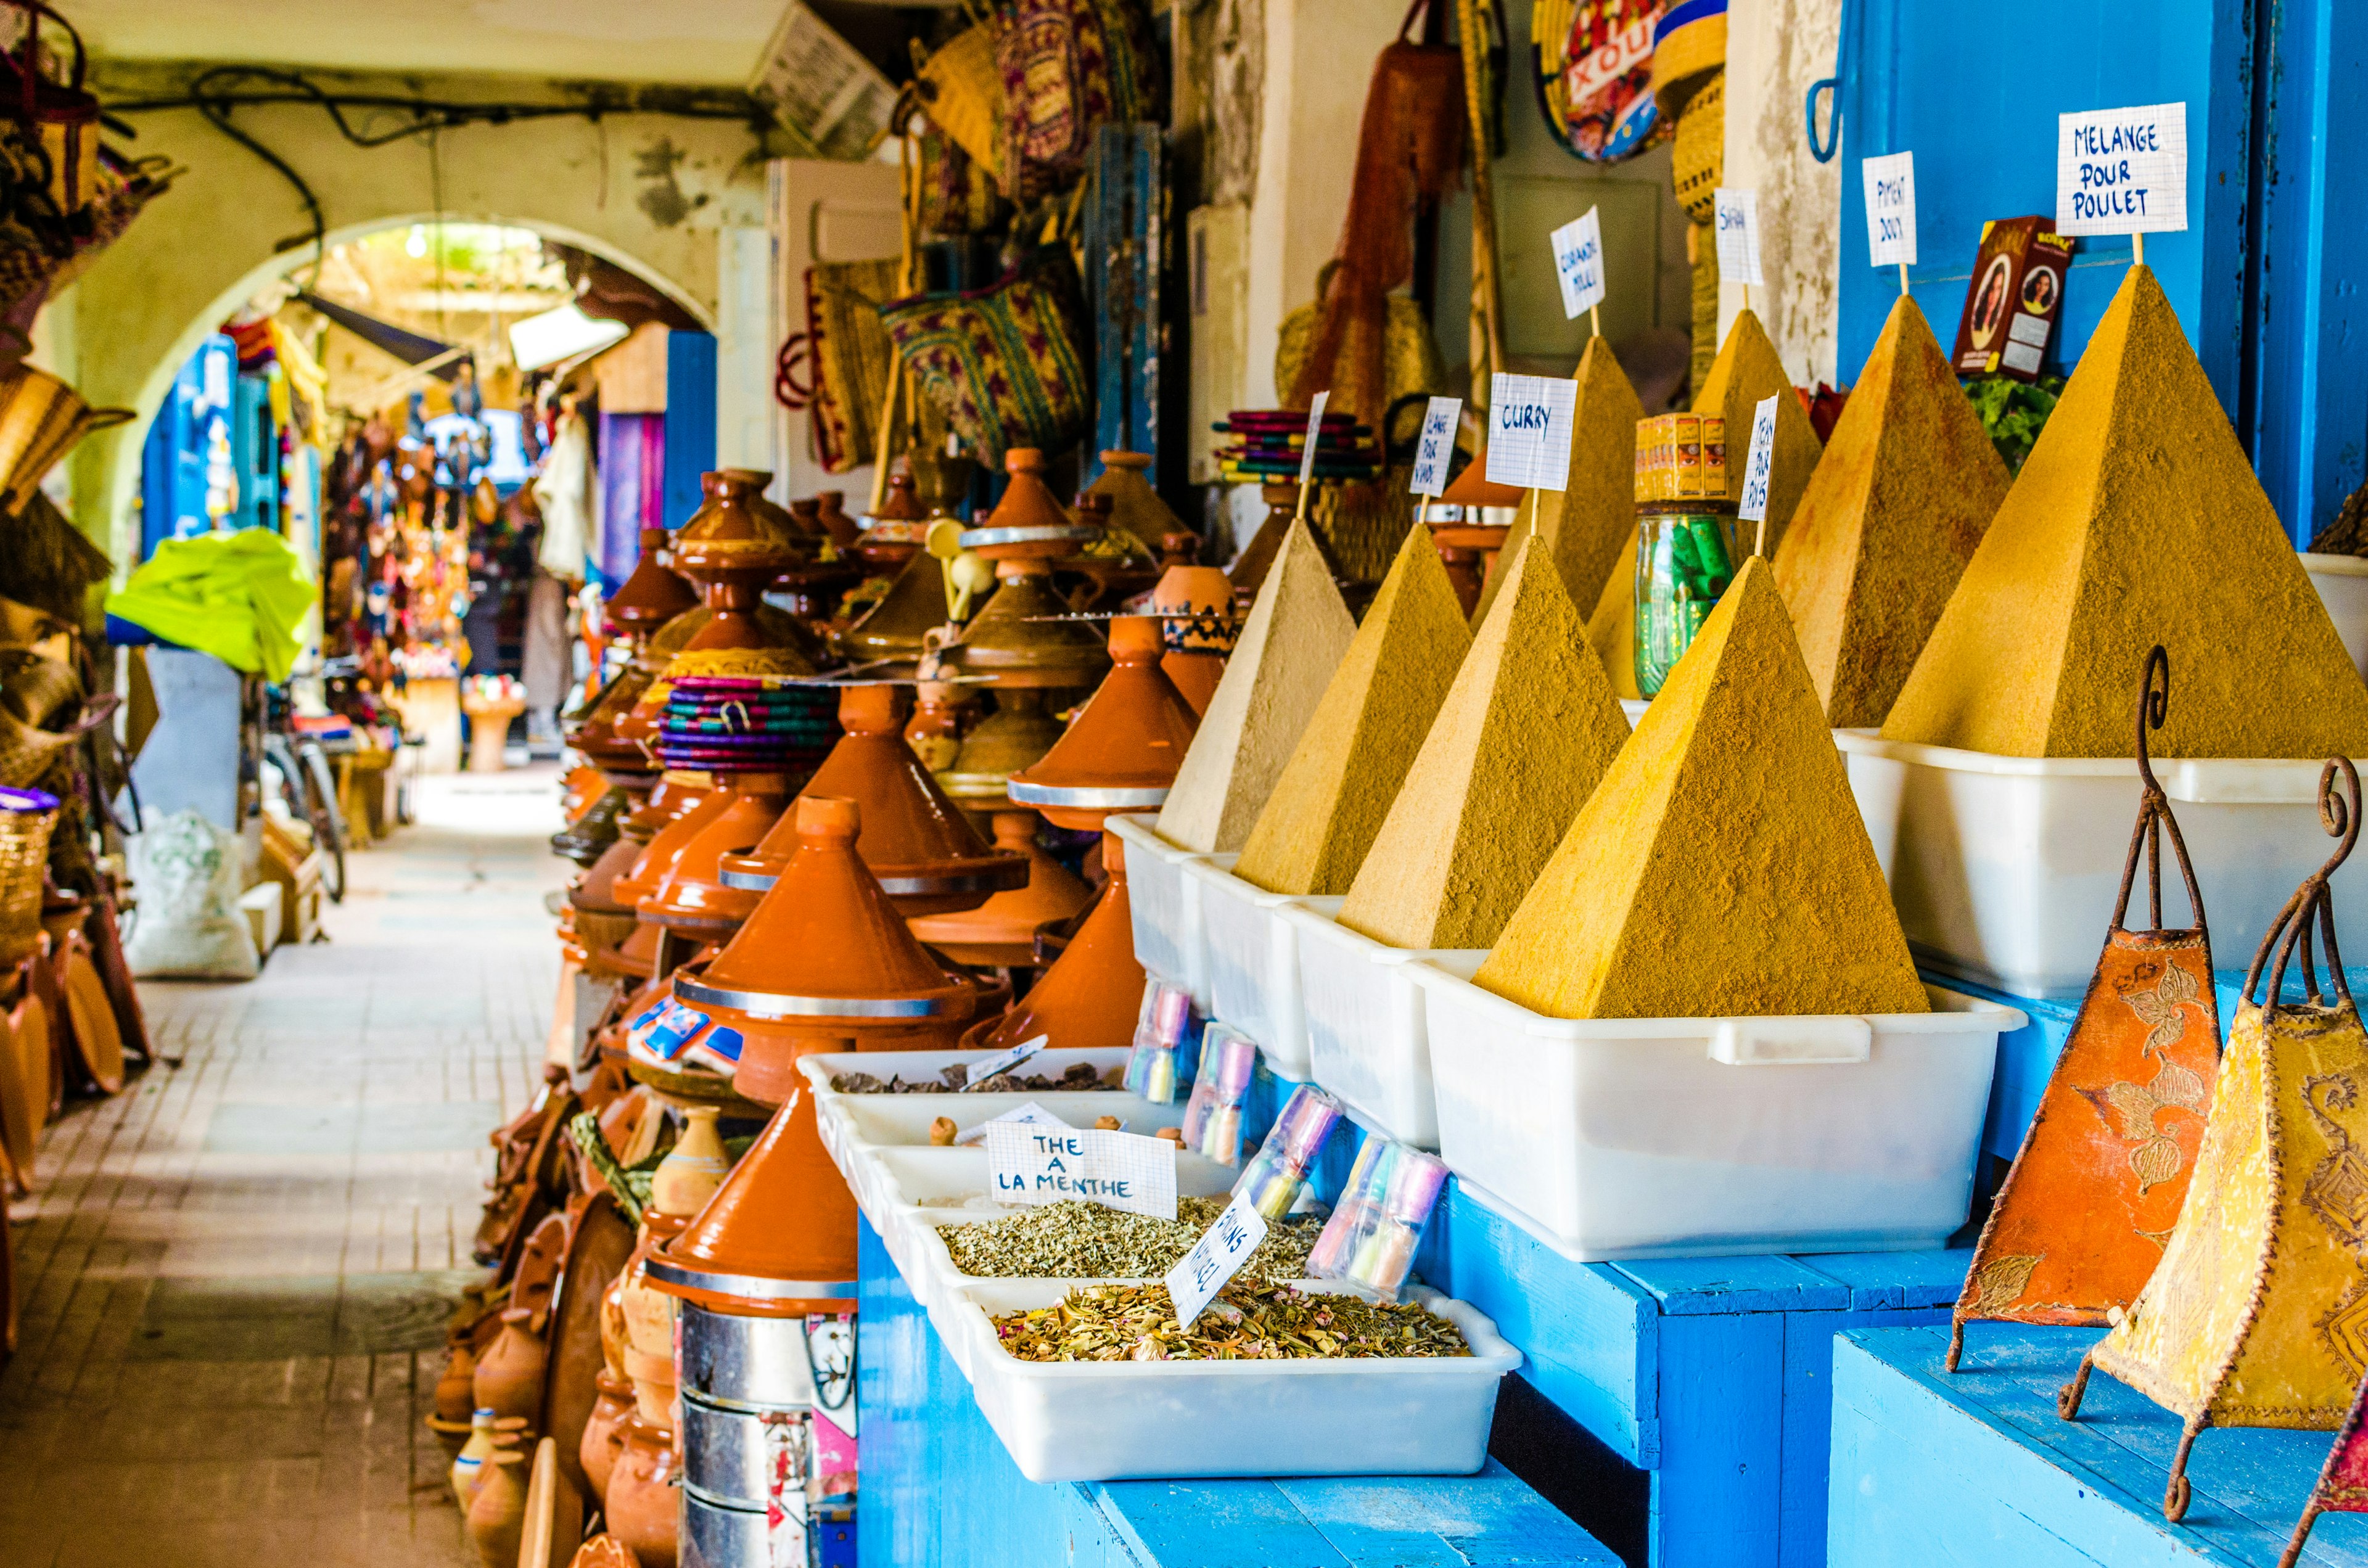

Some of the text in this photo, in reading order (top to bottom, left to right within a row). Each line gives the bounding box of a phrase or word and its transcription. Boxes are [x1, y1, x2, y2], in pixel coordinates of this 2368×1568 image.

[2074, 124, 2160, 157] MELANGE
[2080, 160, 2131, 190] POUR
[2073, 189, 2148, 220] POULET
[1502, 404, 1552, 443] CURRY
[1033, 1135, 1084, 1156] THE
[1047, 1156, 1067, 1173] A
[998, 1173, 1133, 1198] LA MENTHE
[1187, 1236, 1220, 1293] NATUREL
